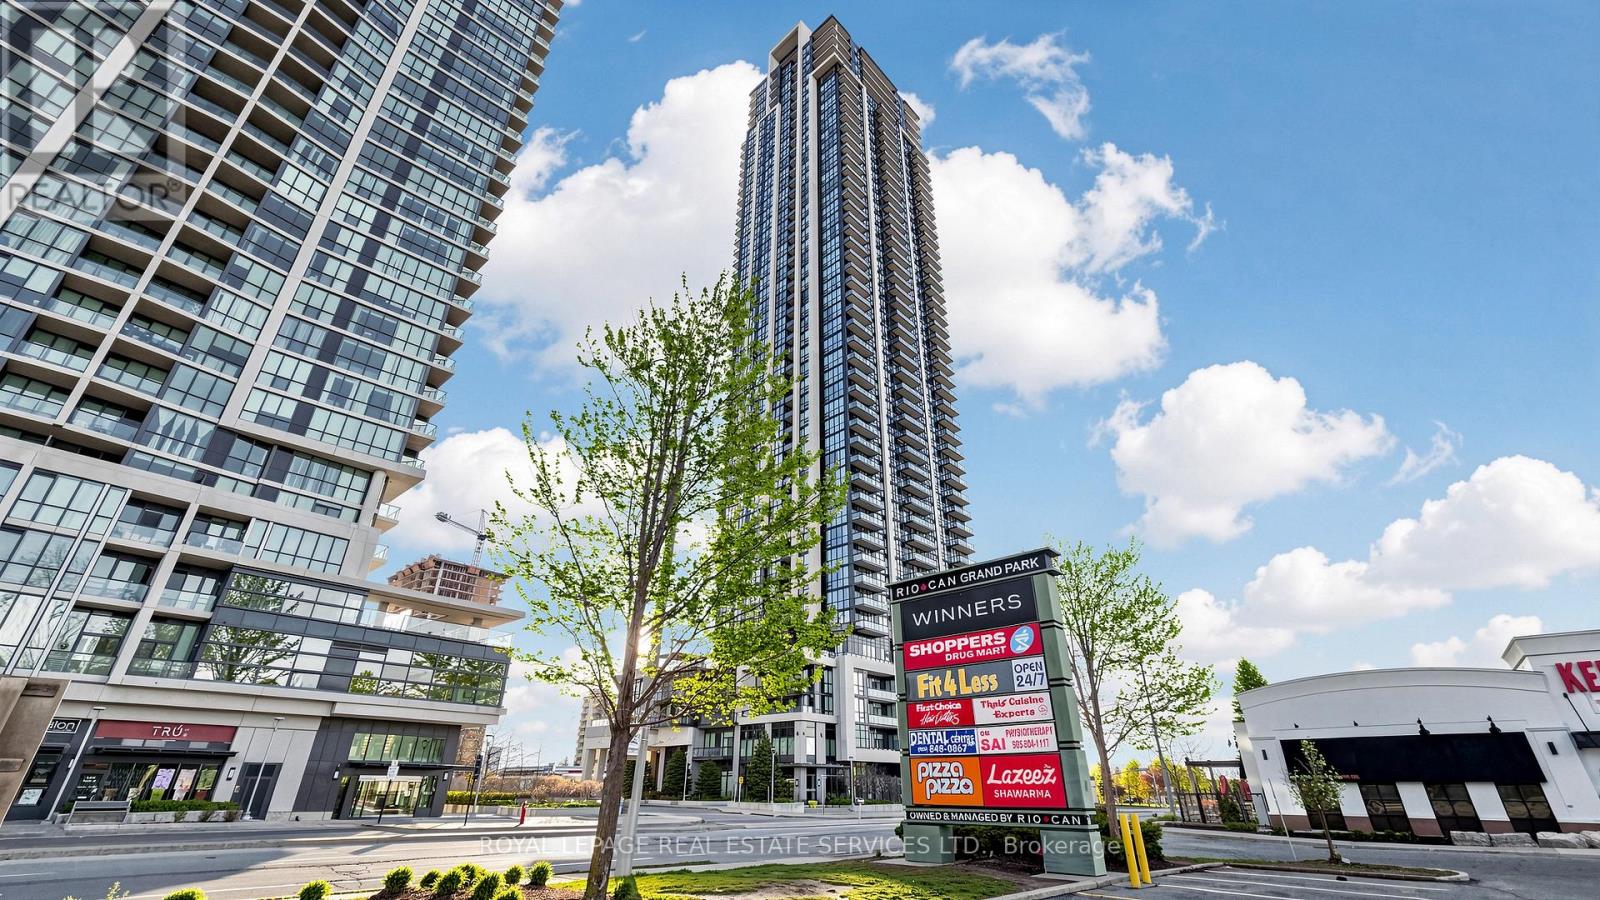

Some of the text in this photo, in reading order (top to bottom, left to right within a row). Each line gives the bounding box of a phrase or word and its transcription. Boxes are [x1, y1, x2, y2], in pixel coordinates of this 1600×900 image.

[960, 566, 1002, 583] GRAND
[1004, 557, 1040, 574] PARK
[912, 594, 1022, 626] WINNERS
[909, 631, 1006, 657] SHOPPERS
[945, 645, 1007, 662] DRUG MART
[1014, 661, 1043, 674] OPEN
[916, 668, 999, 699] Fit 4 Less
[1016, 672, 1045, 687] 24/7
[916, 703, 935, 712] First
[993, 709, 1036, 719] Experts
[910, 731, 949, 746] DENTAL
[980, 738, 1006, 751] SAI
[917, 762, 963, 783] pizza
[925, 777, 974, 800] pizza
[994, 789, 1052, 799] SHAWARMA
[909, 812, 942, 821] OWNED
[943, 812, 950, 821] &
[951, 812, 999, 822] MANAGED
[1000, 813, 1013, 823] BY
